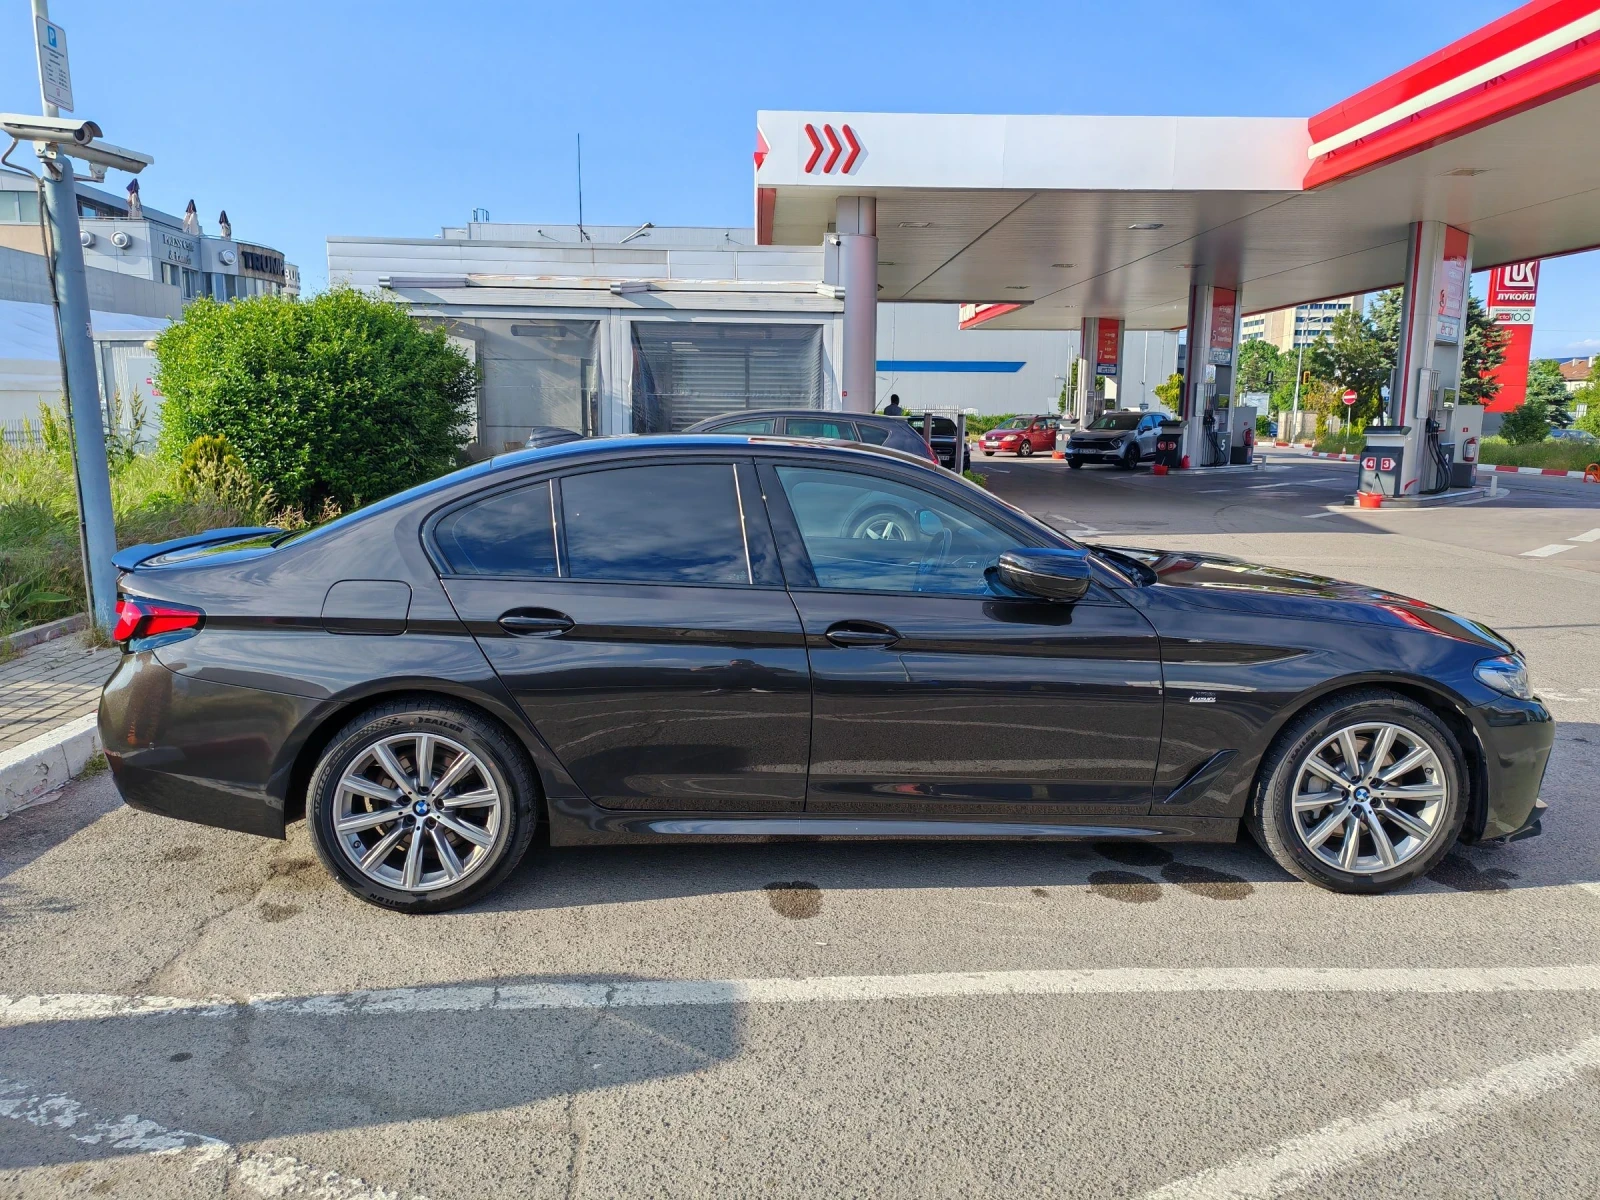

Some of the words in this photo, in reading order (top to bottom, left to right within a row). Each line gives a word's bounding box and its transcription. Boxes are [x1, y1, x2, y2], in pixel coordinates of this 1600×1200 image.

[1496, 291, 1536, 301] ЛУКОЙЛ
[1511, 313, 1531, 322] 100
[1220, 439, 1226, 451] 5
[1366, 459, 1374, 468] 4
[1383, 460, 1390, 468] 3
[422, 717, 464, 733] SAILUN
